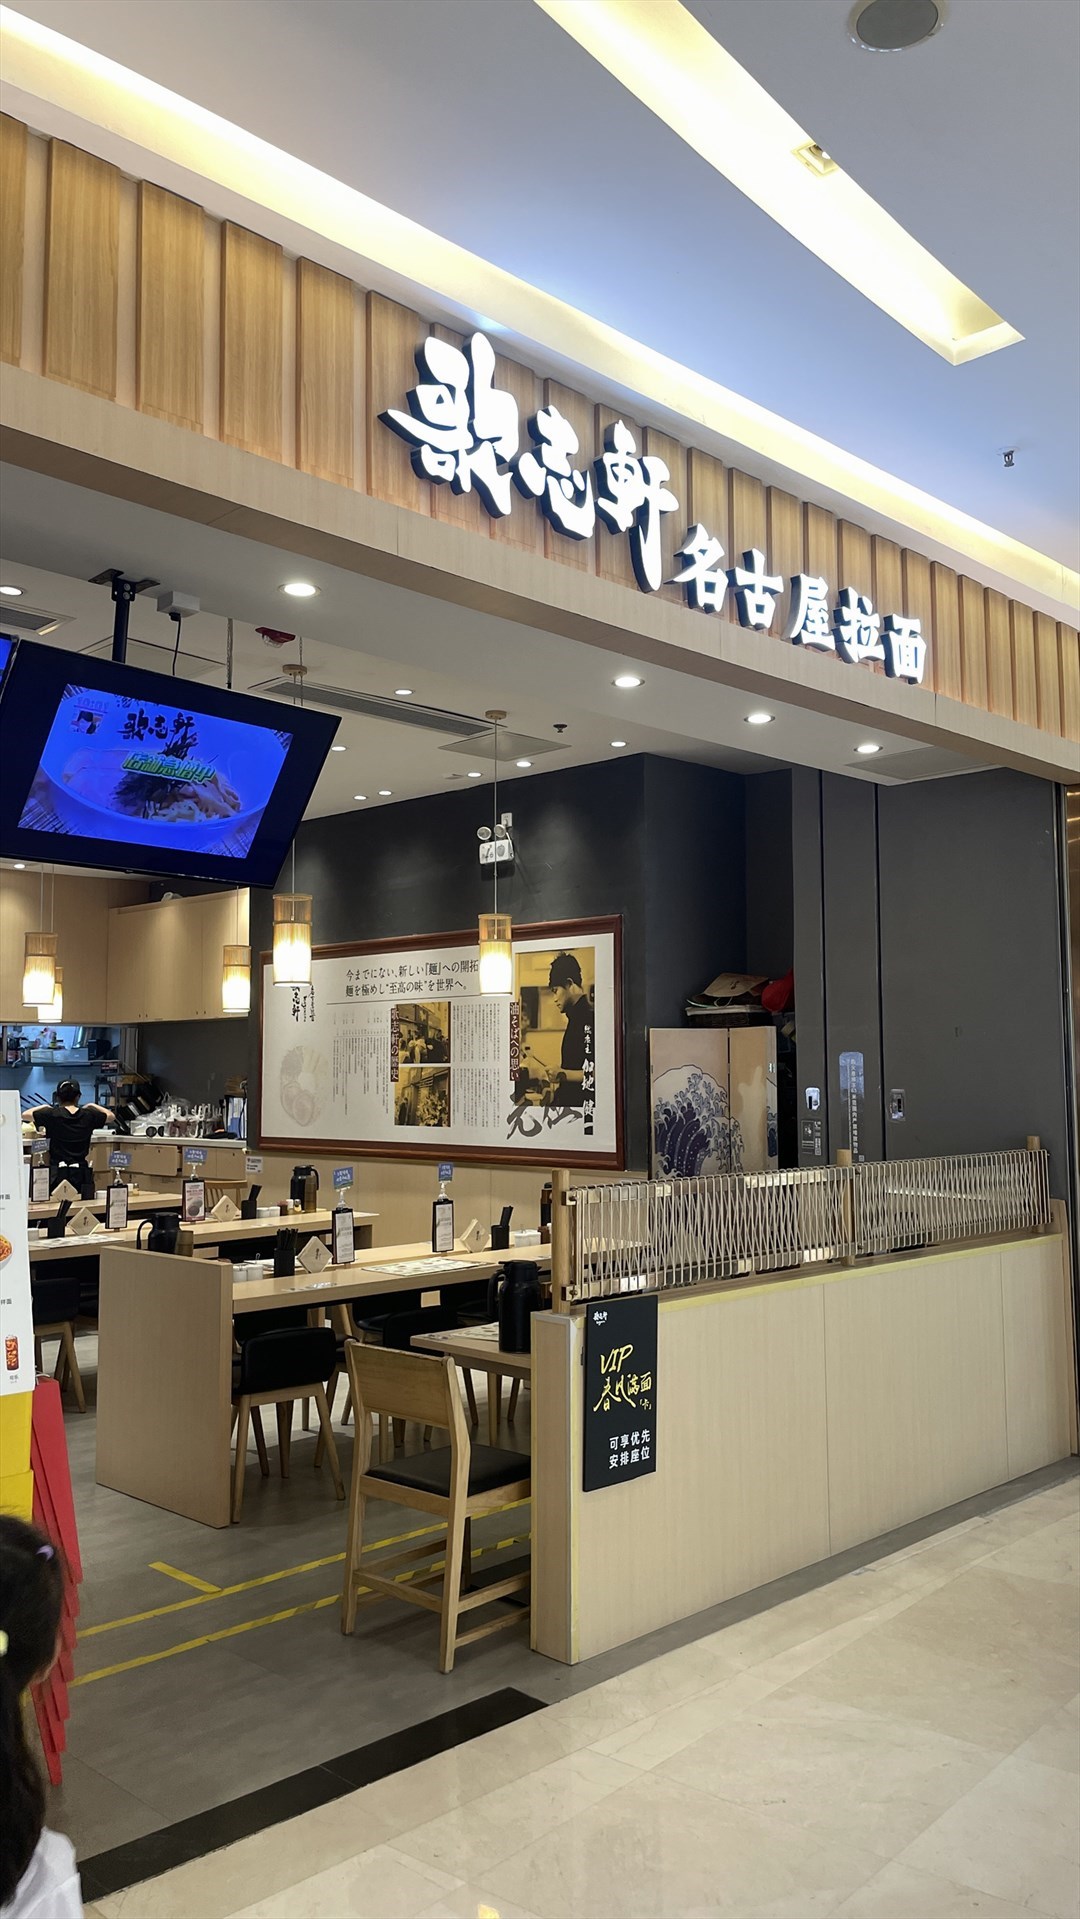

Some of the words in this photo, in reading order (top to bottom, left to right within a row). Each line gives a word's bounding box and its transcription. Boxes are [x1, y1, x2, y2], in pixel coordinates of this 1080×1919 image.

[665, 523, 927, 684] 名古屋拉面
[510, 1003, 520, 1080] 油そばへの思い
[600, 1344, 633, 1375] VIP
[609, 1428, 651, 1451] 可享优先
[608, 1446, 651, 1469] 安排座位
